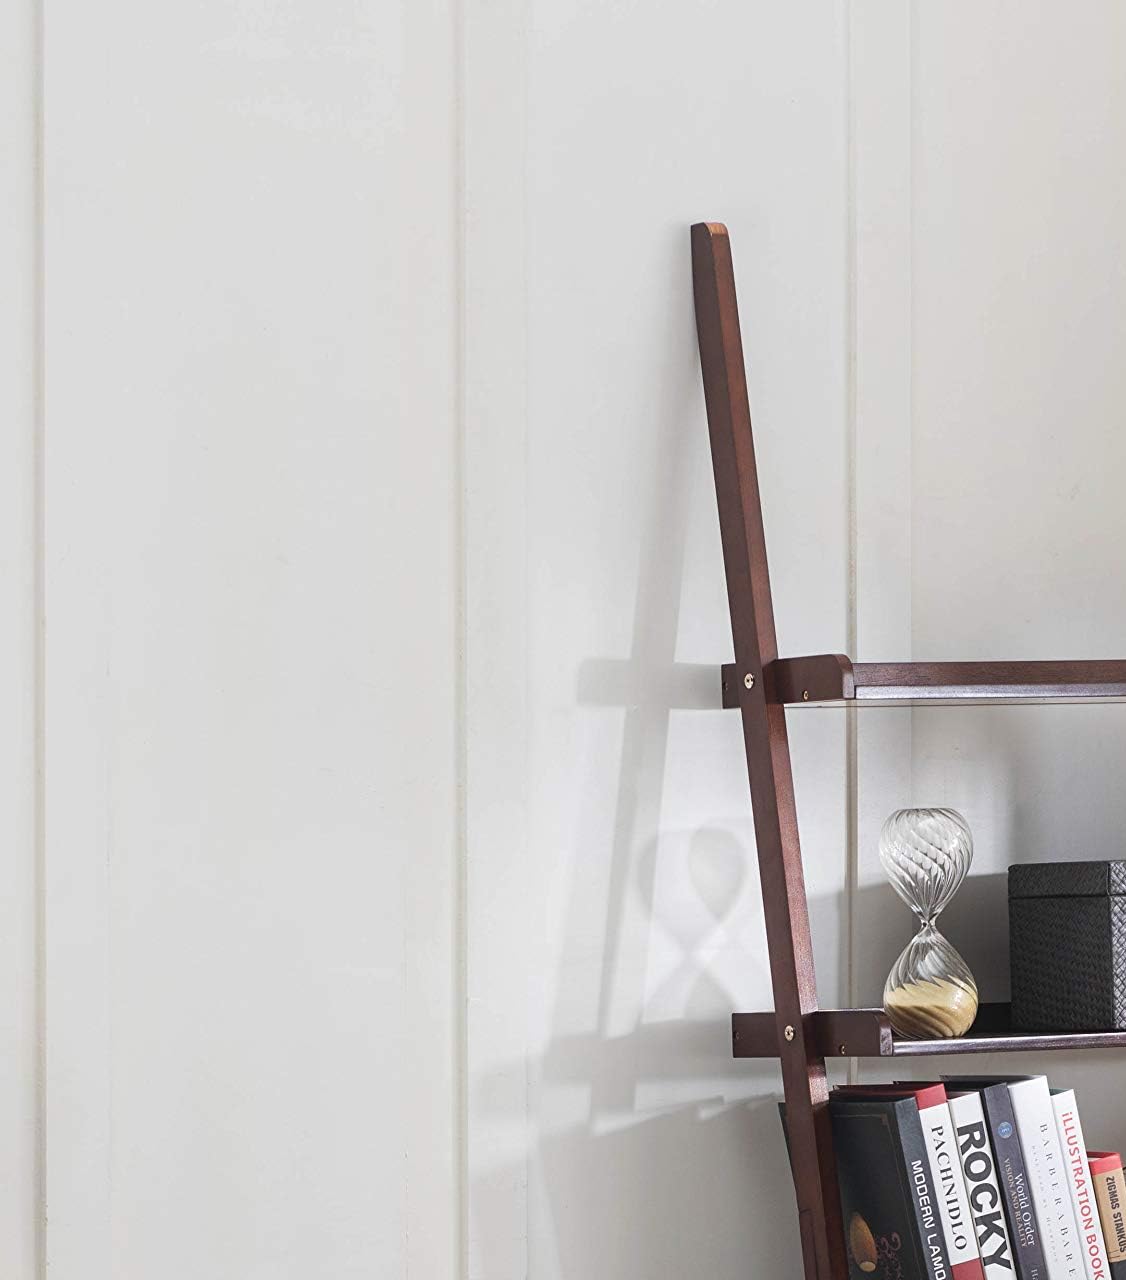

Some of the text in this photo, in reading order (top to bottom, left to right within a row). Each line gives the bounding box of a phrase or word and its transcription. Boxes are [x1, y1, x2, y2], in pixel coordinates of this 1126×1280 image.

[957, 1121, 1012, 1270] ROCKY
[1004, 1158, 1027, 1247] VISION AND REALITY
[1014, 1173, 1035, 1246] World Order
[1106, 1176, 1120, 1210] ZIGMAS
[1086, 1233, 1104, 1280] BOOK
